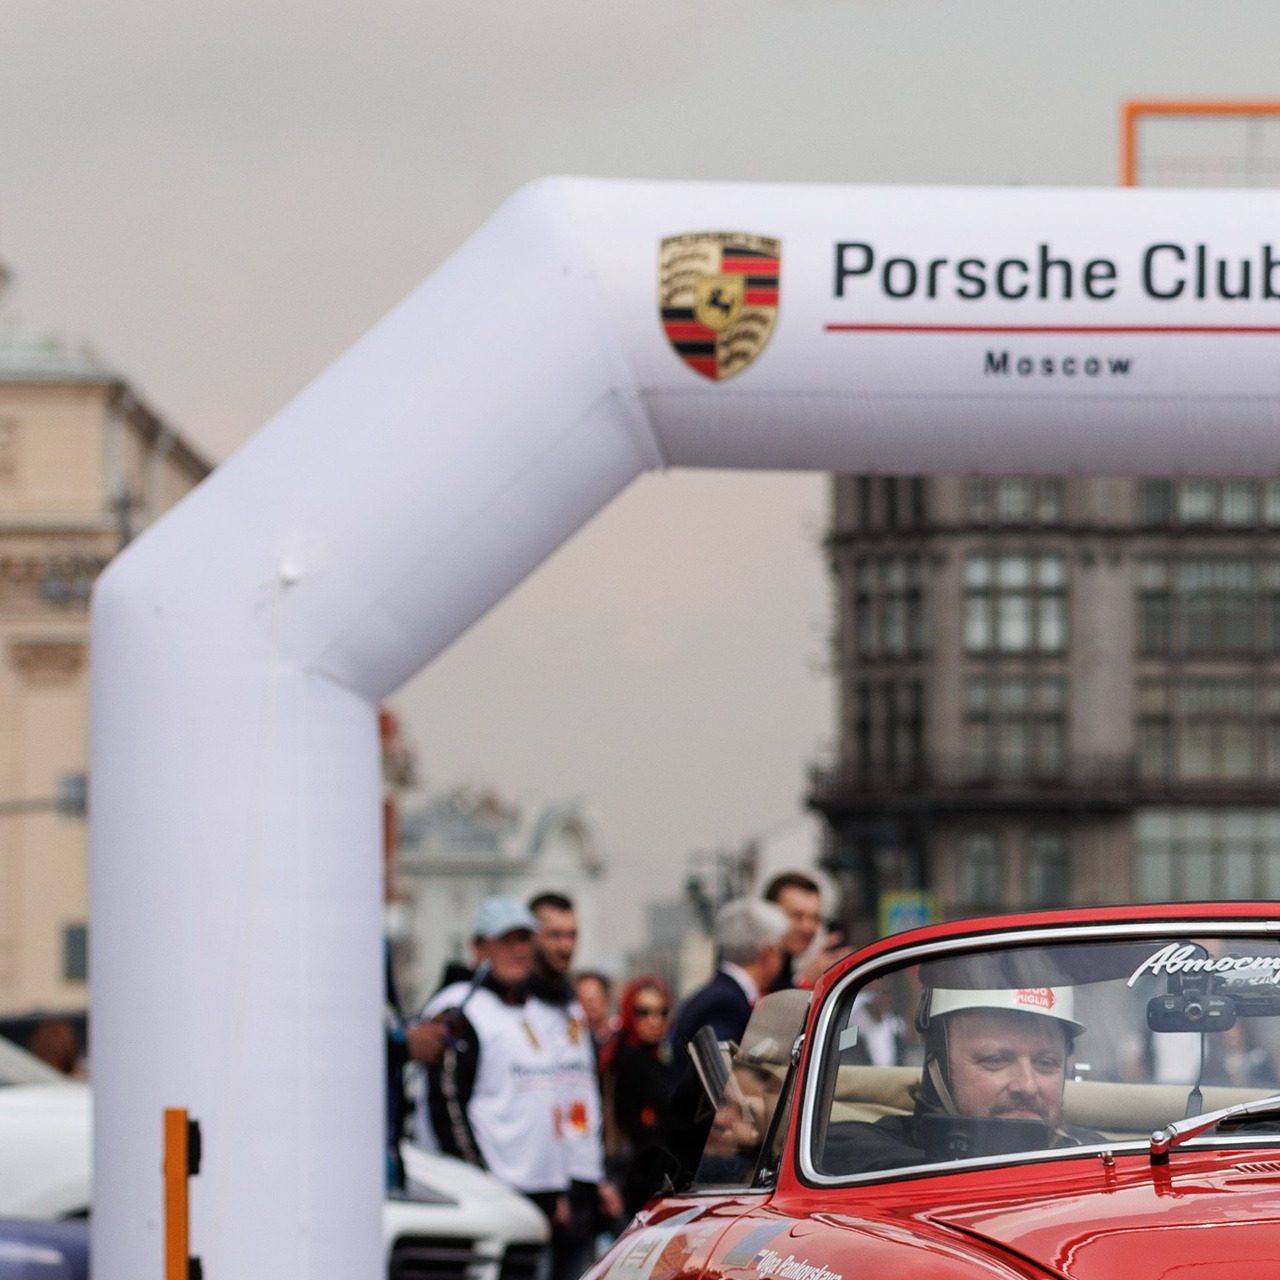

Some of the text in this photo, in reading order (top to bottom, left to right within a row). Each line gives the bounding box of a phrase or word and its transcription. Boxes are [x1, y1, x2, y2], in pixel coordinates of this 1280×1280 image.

[833, 242, 1118, 301] Porsche
[983, 350, 1134, 378] Moscow
[756, 1249, 783, 1279] Olga
